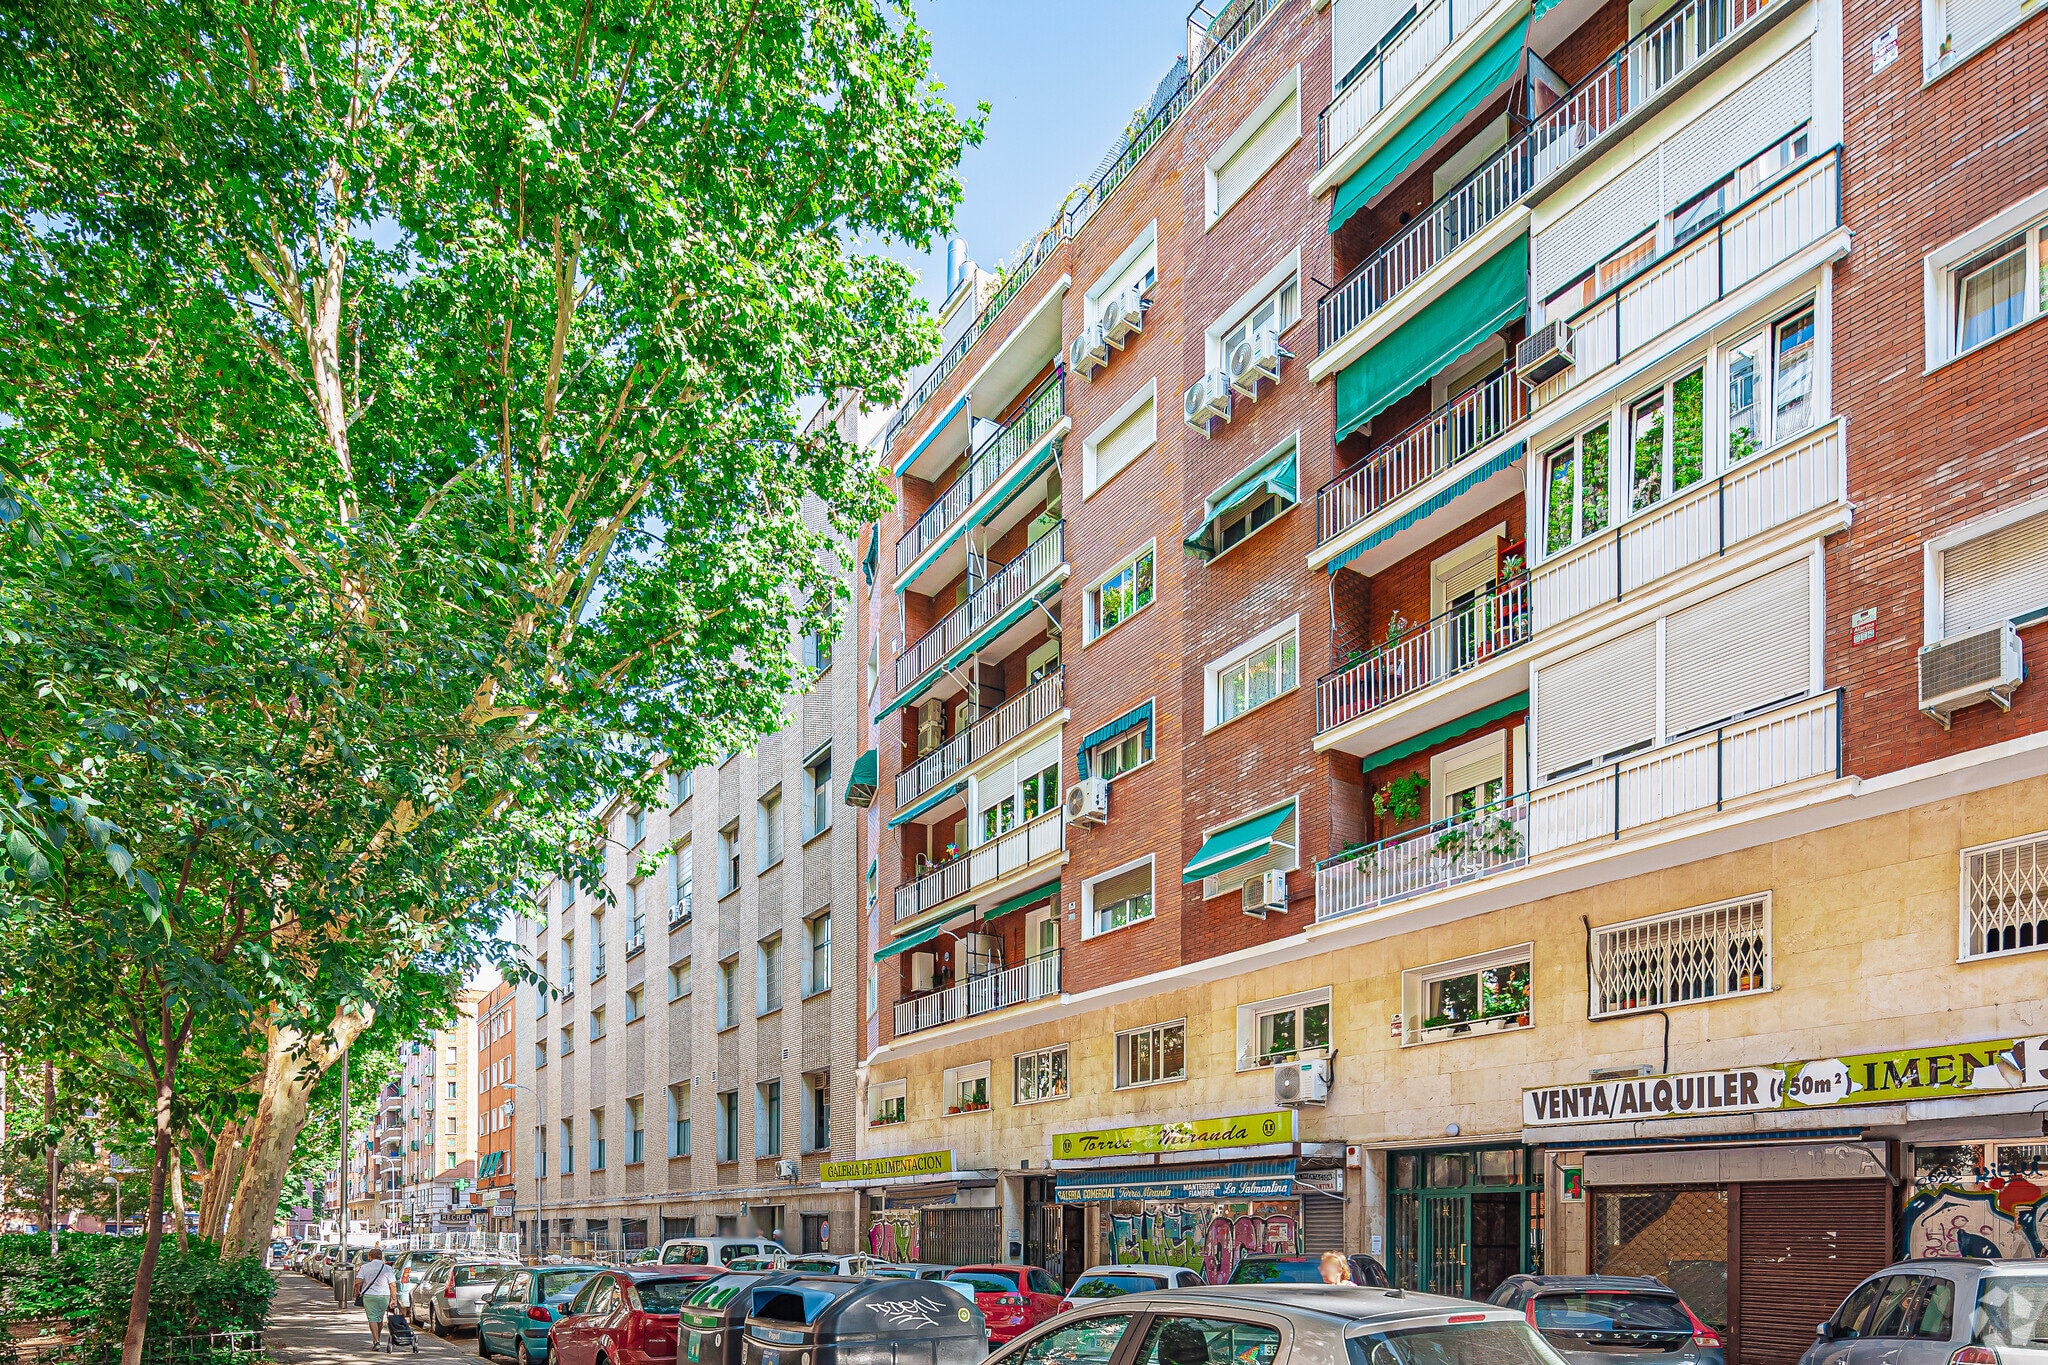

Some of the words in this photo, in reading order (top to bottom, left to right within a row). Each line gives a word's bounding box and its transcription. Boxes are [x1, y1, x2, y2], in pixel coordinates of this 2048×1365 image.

[1531, 1072, 1760, 1120] VENTA/ALQUILER
[1079, 1135, 1131, 1151] Torres
[1157, 1124, 1248, 1145] Miranda
[828, 1164, 860, 1177] GALERIA
[862, 1163, 873, 1175] DE
[875, 1155, 942, 1174] ALIMENTACION
[1083, 1188, 1115, 1199] COMERCIAL
[1141, 1186, 1171, 1197] Miranda
[1223, 1182, 1236, 1195] La
[1239, 1181, 1288, 1194] Salmantina
[1575, 1332, 1659, 1340] VOLVO
